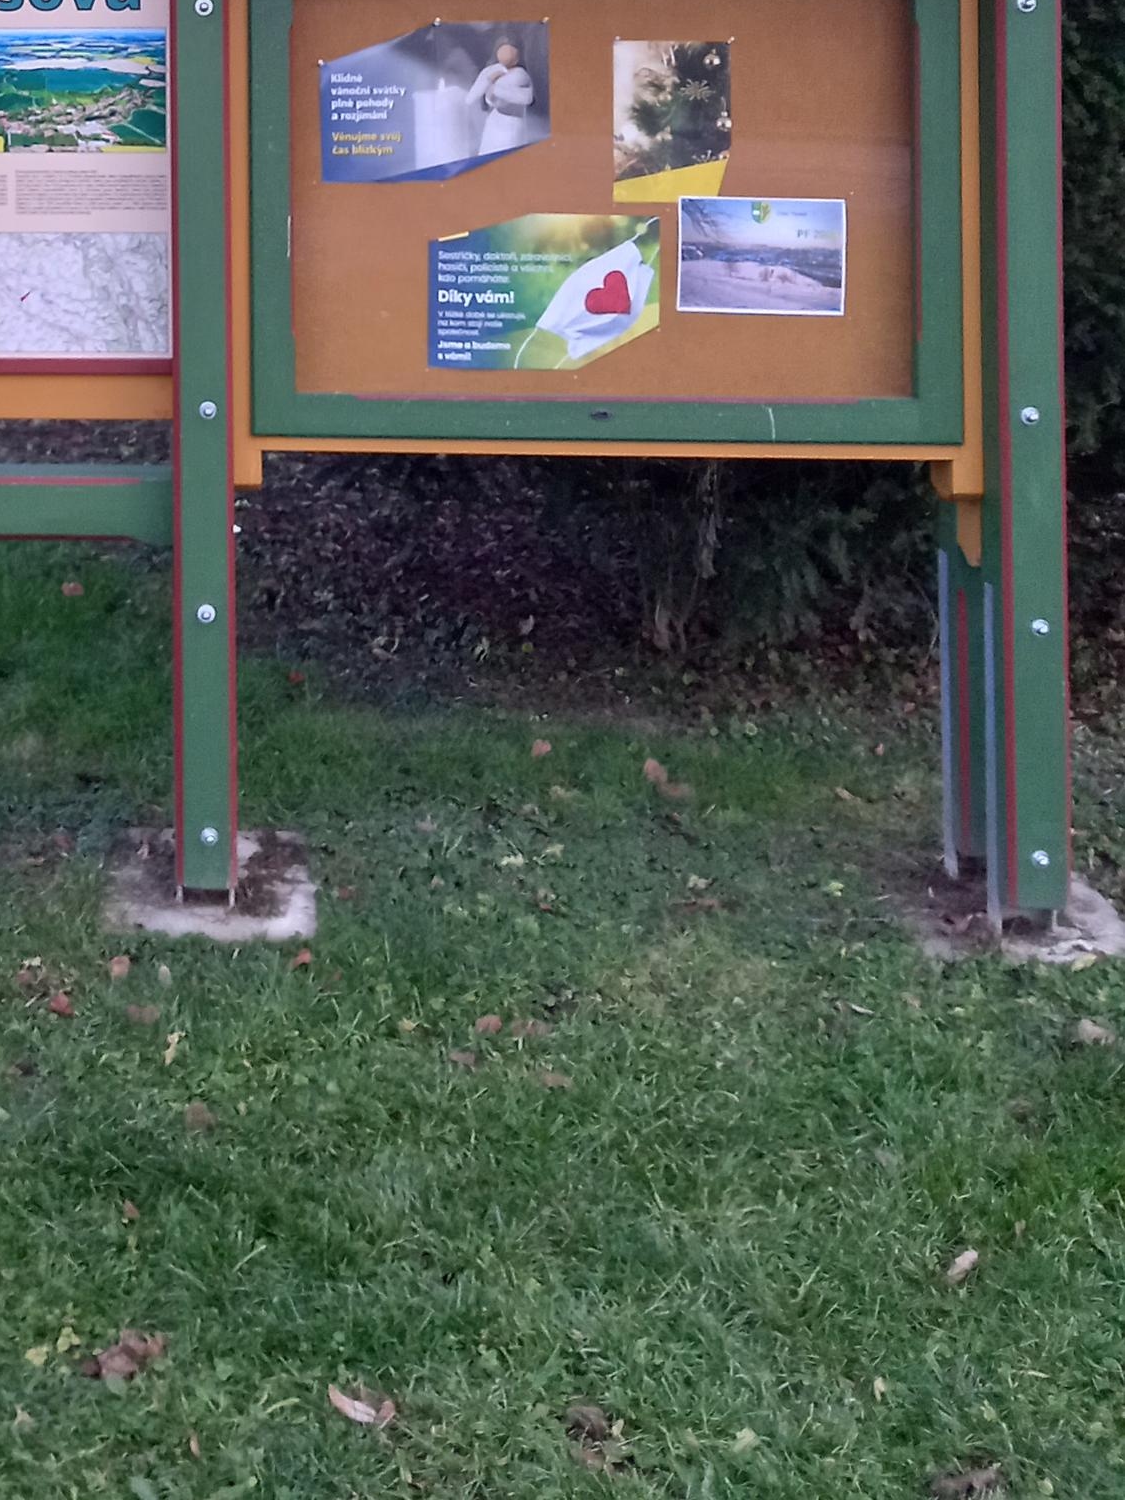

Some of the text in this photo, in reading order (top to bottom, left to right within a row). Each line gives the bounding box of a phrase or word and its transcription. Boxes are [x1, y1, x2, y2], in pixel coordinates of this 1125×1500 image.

[330, 73, 363, 83] Klidné
[330, 85, 406, 97] vánoční svátky
[331, 98, 394, 110] plné pohody
[331, 110, 387, 123] a rozjímání
[331, 131, 402, 143] Věnujme svůj
[331, 144, 394, 157] čas blízkým
[438, 274, 456, 283] kdo
[438, 289, 515, 307] Díky vám!
[437, 340, 463, 349] Jsme
